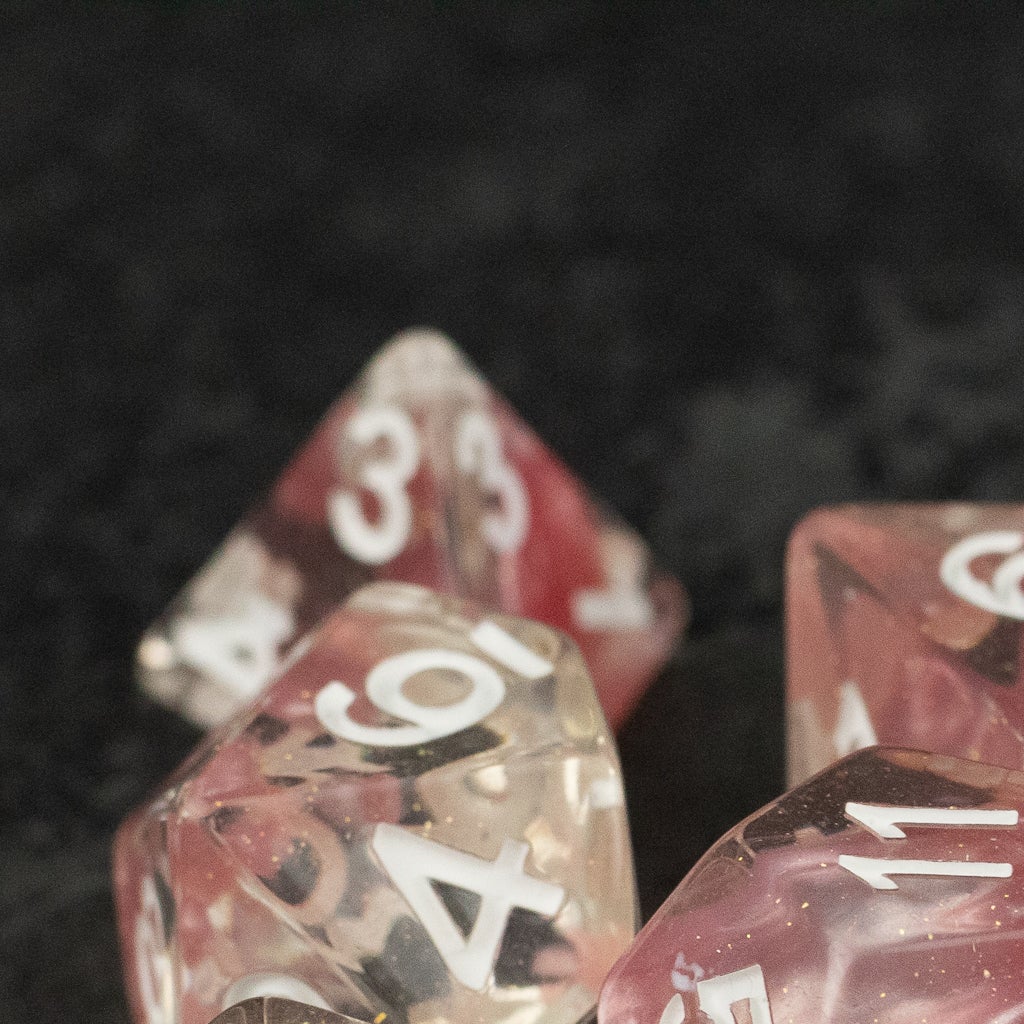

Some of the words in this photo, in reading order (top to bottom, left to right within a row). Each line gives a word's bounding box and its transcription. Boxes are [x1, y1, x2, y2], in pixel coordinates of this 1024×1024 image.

[332, 404, 420, 566] 3
[371, 824, 565, 989] 4
[838, 802, 1020, 890] 11
